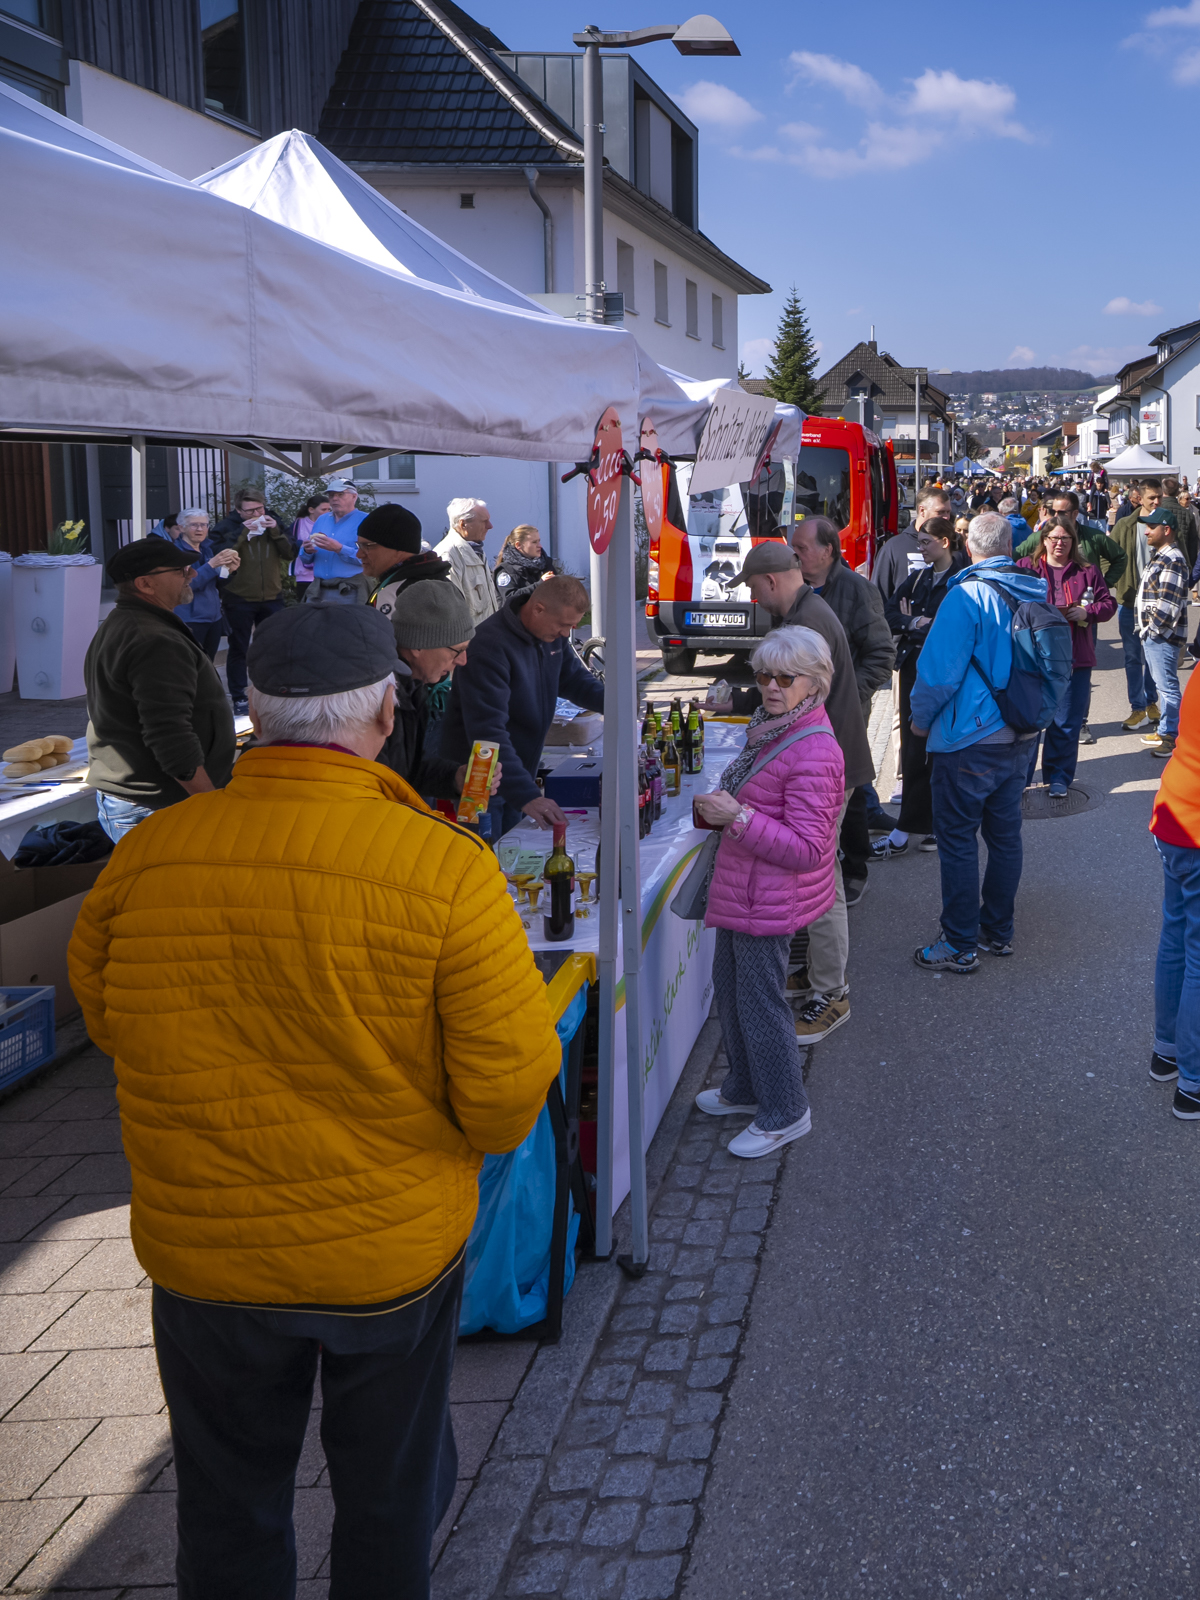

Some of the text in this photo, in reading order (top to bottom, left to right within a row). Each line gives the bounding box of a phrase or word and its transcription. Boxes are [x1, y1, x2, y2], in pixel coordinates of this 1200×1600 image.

[691, 613, 744, 624] WT CV 4001
